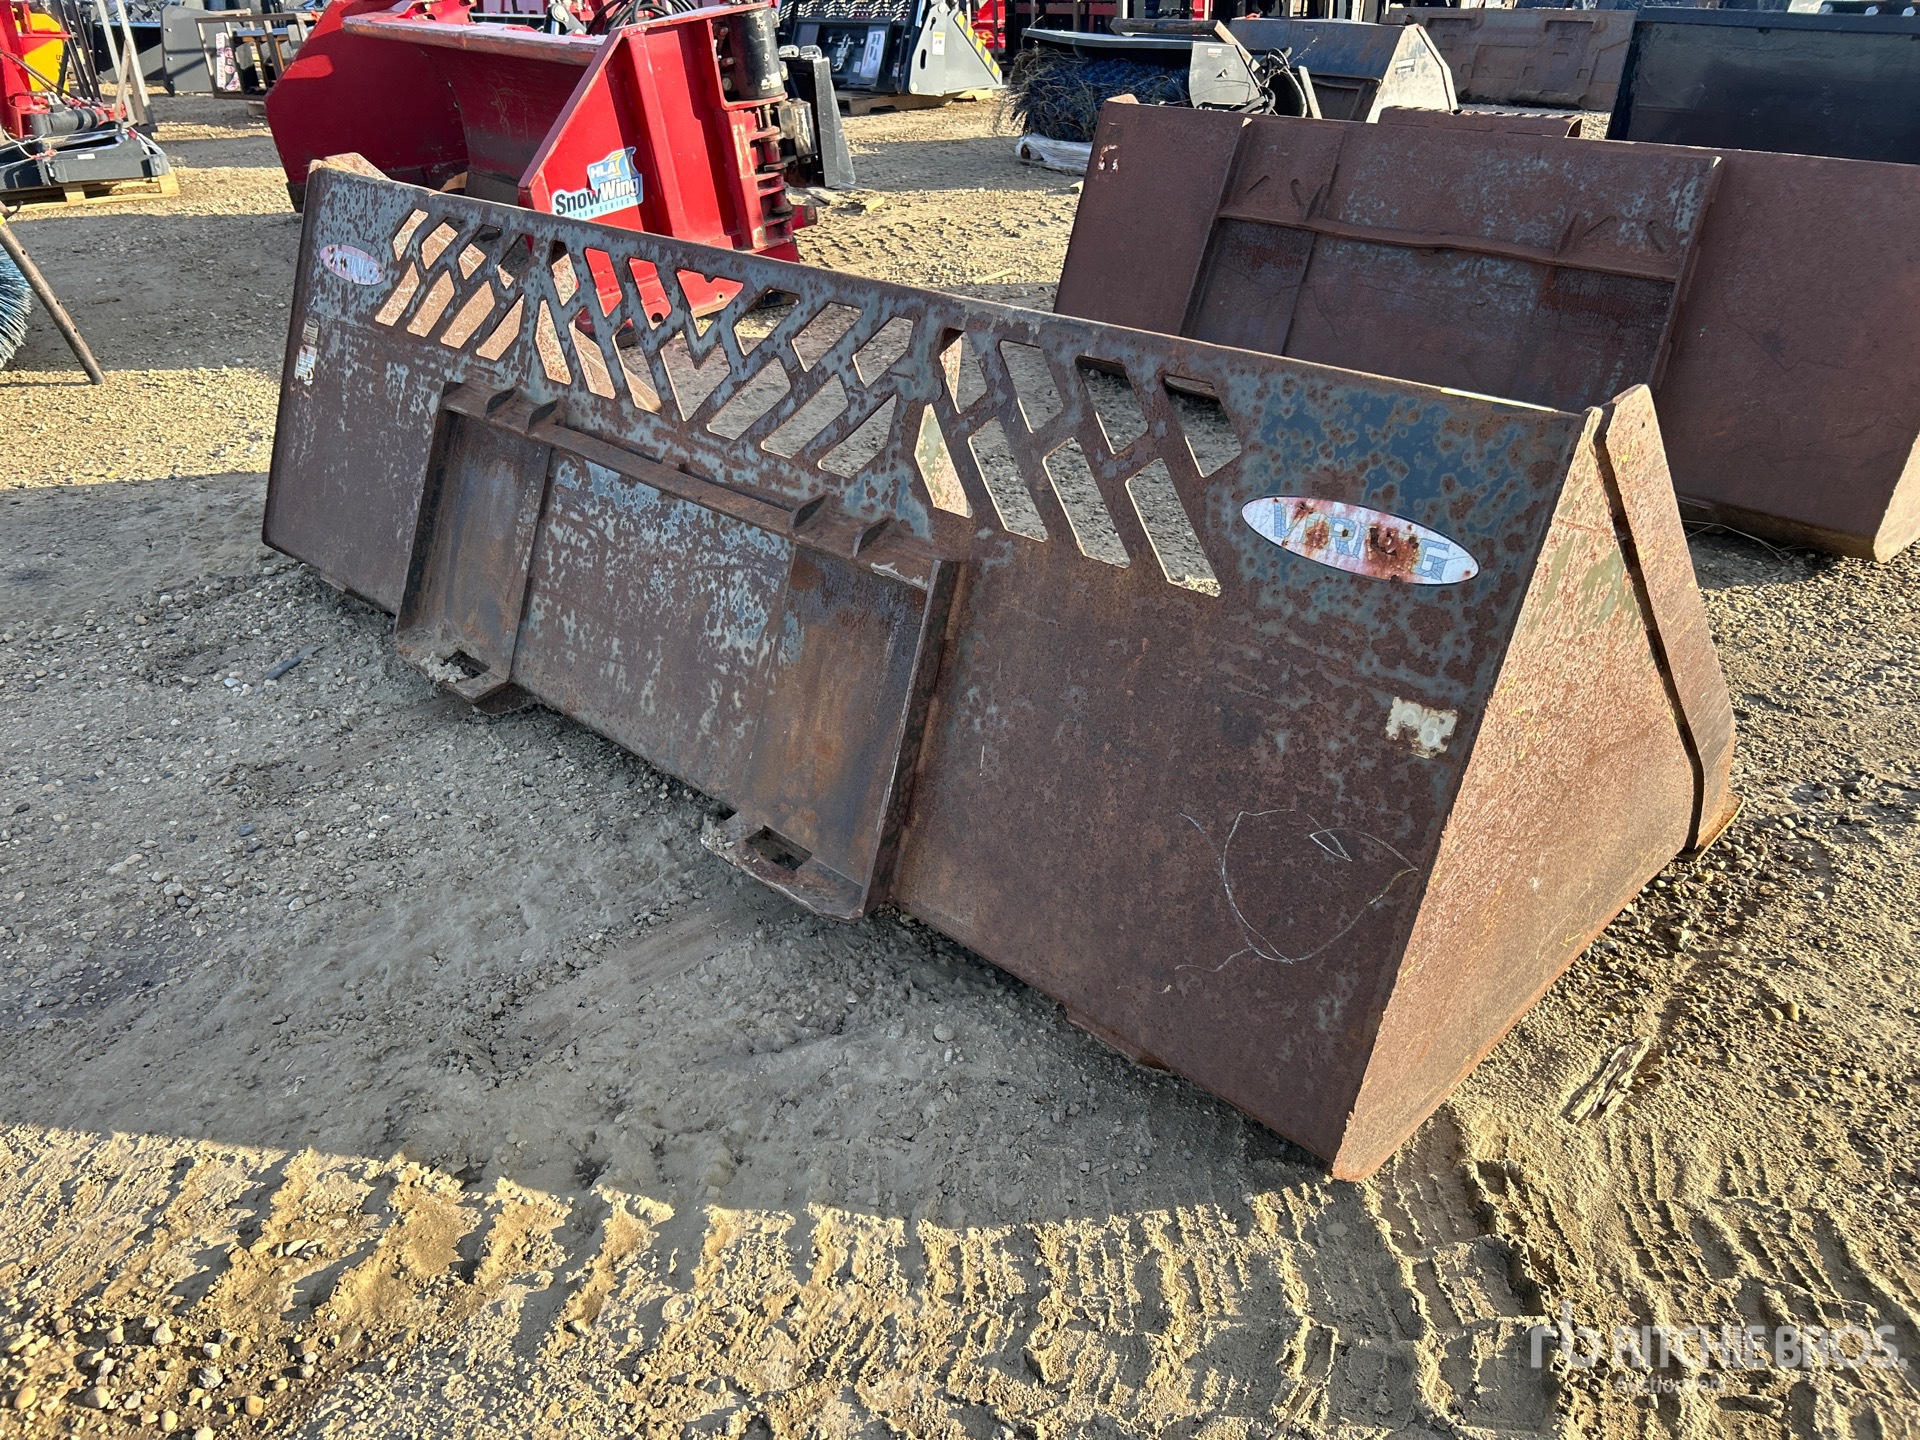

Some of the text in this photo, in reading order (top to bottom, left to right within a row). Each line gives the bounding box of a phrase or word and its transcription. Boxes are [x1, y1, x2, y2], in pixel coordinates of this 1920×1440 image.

[590, 163, 616, 178] HLA
[555, 177, 640, 216] SnowWing
[599, 198, 630, 212] SERIES
